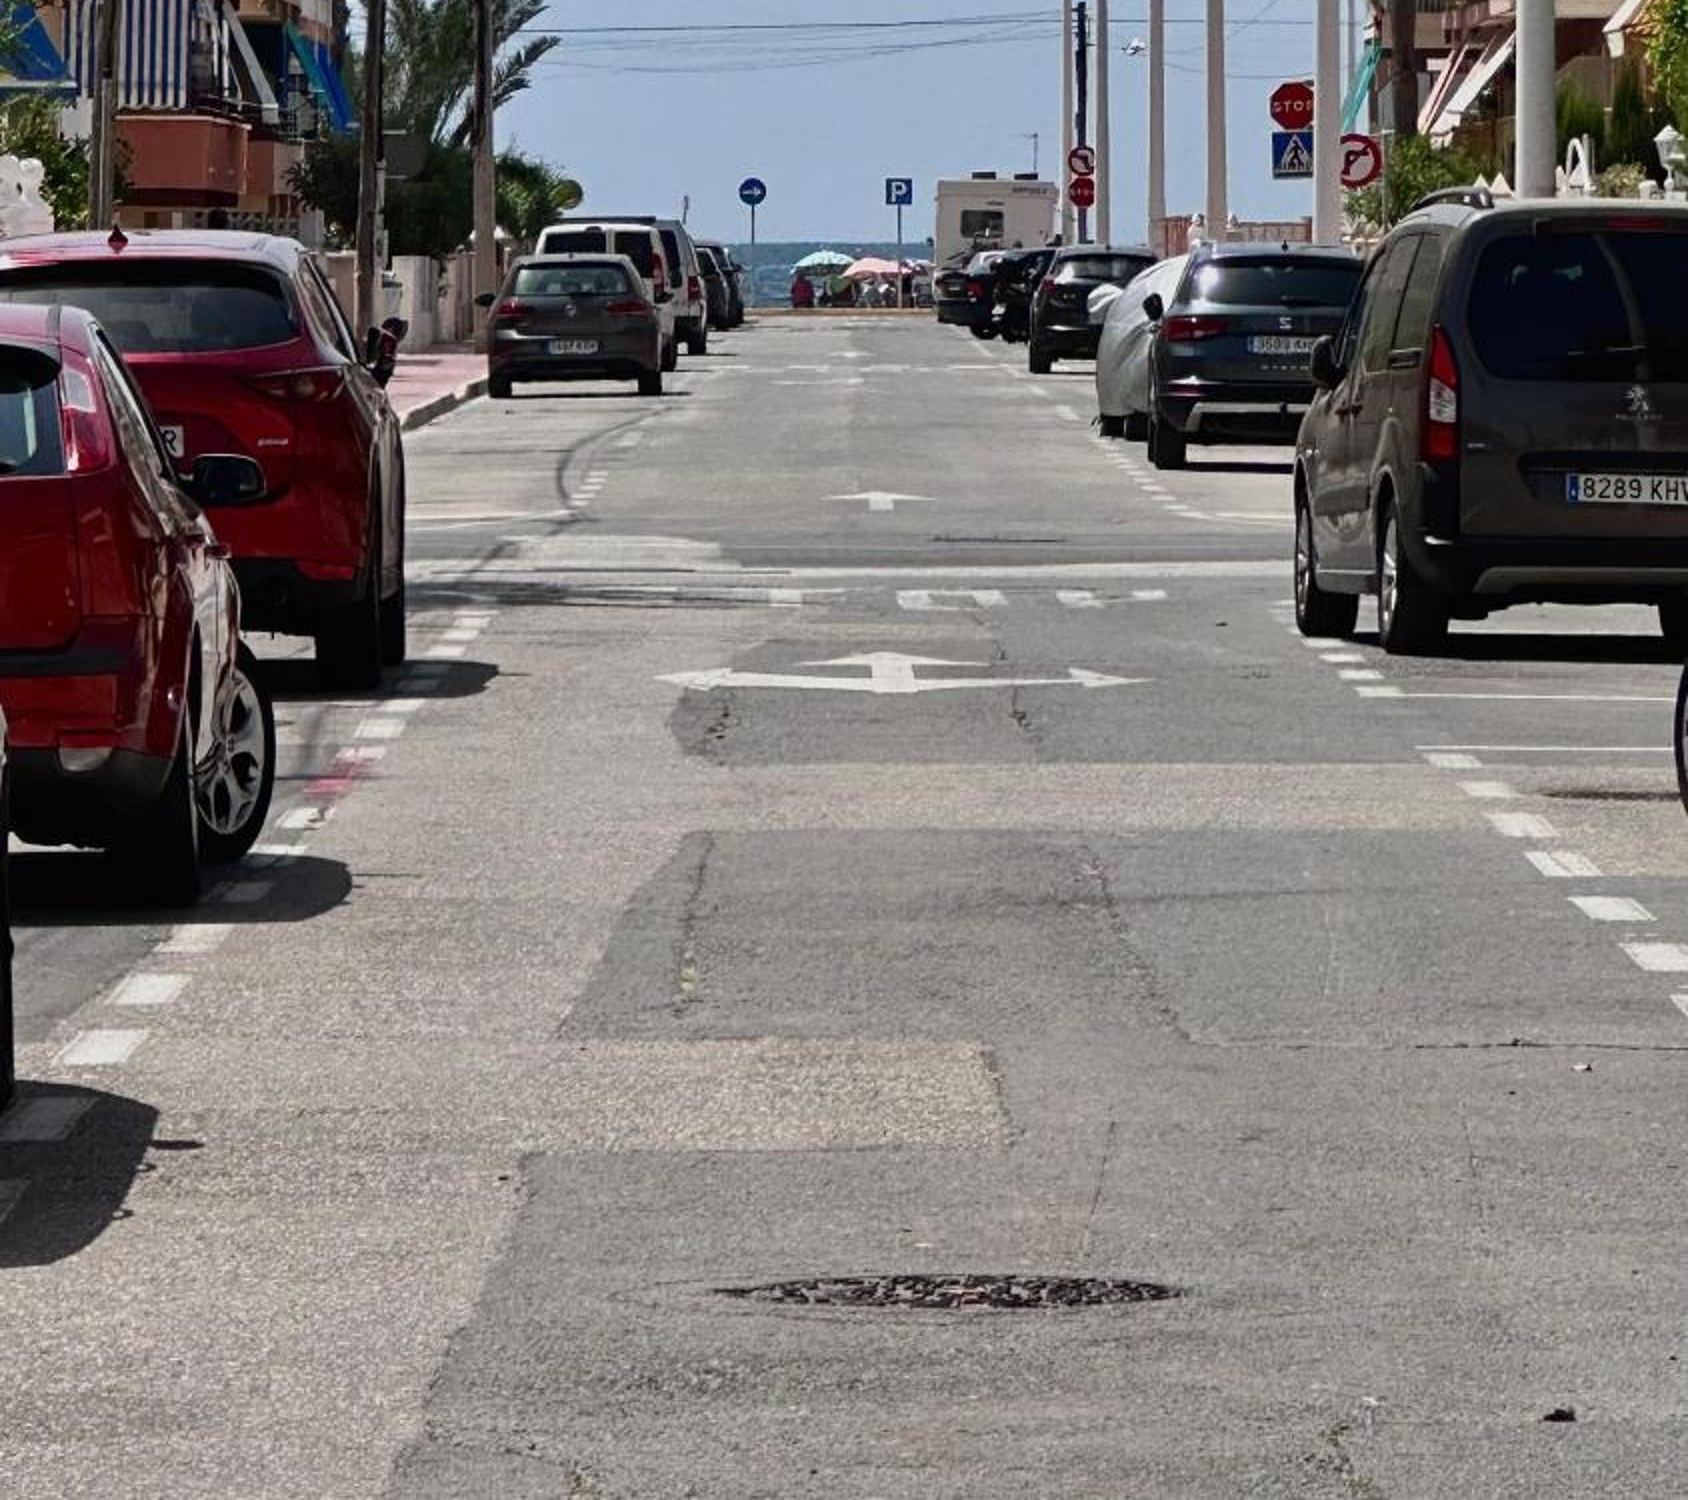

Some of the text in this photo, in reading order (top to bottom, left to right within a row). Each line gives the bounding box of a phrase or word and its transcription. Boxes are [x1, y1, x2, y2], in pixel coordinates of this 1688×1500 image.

[1272, 100, 1313, 114] STOP
[890, 181, 907, 202] P
[1583, 477, 1642, 499] 8289
